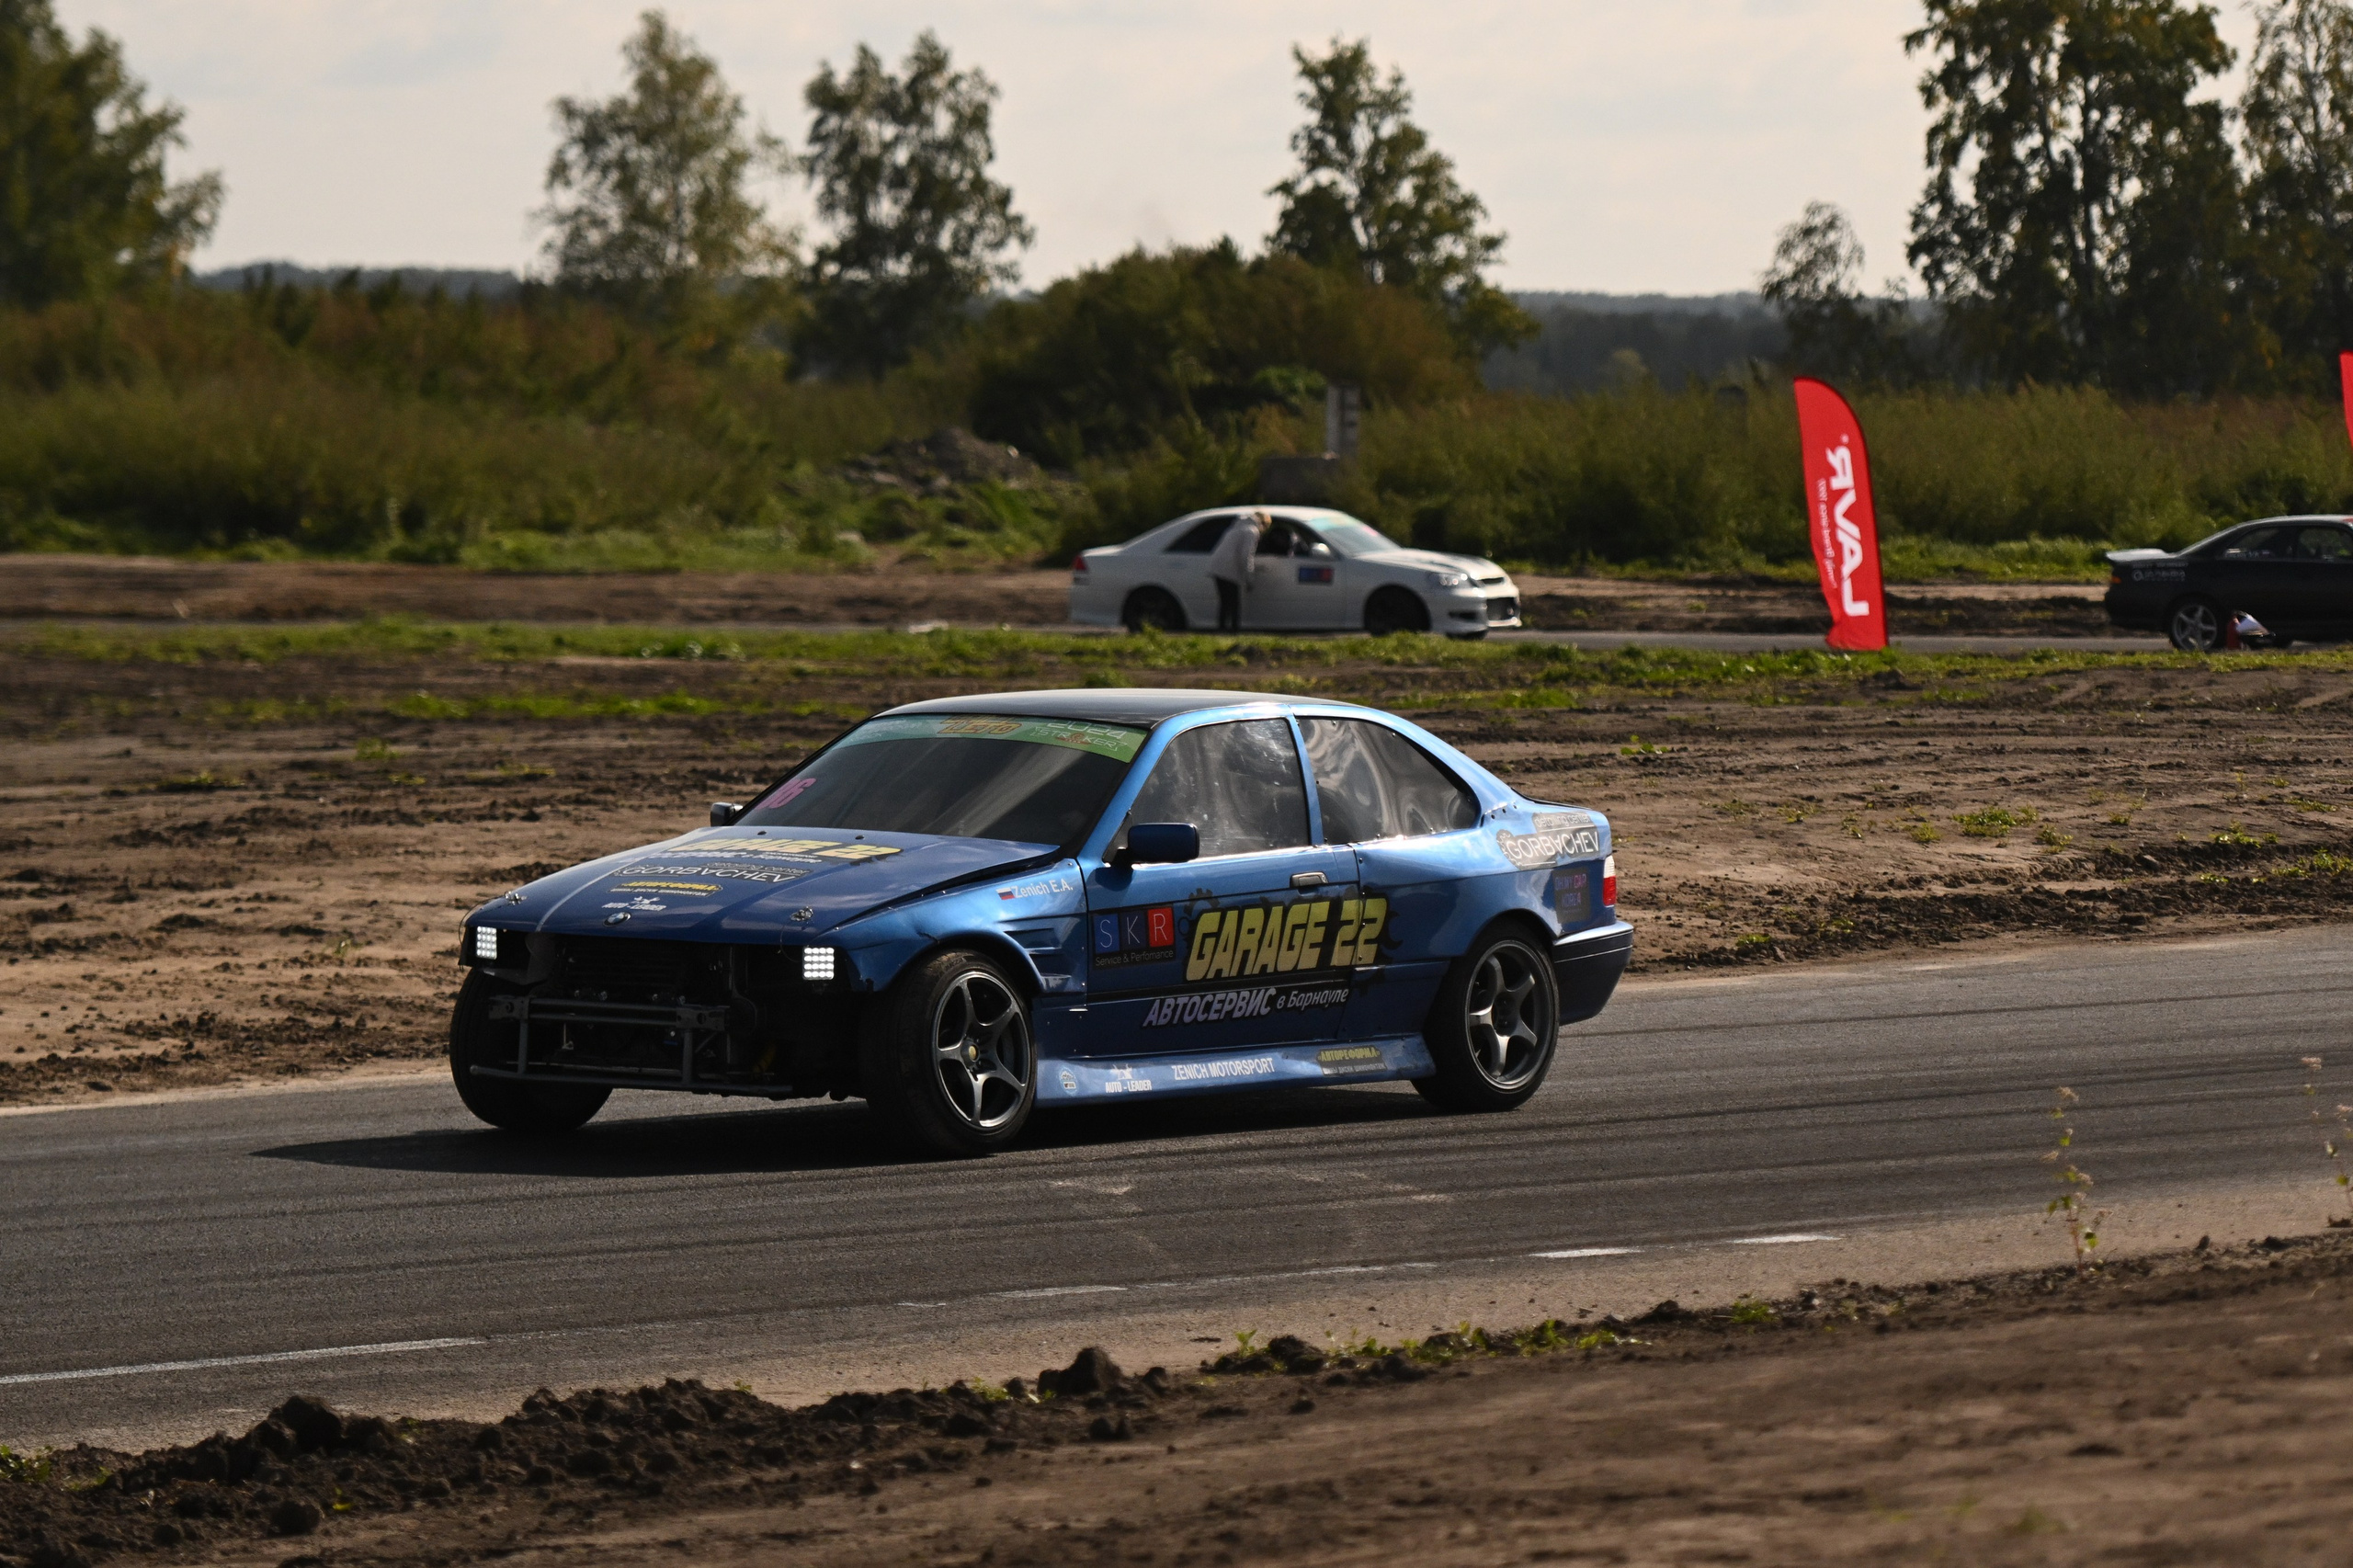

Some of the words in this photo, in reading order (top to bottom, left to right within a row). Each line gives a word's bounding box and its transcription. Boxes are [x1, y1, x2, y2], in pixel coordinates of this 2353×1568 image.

[1012, 881, 1050, 899] Zenich
[1186, 901, 1331, 981] GARAGE
[1331, 897, 1388, 967] 22
[1096, 955, 1121, 966] Service
[1123, 954, 1129, 963] &
[1142, 987, 1277, 1028] АВТОСЕРВИС
[1277, 996, 1285, 1009] в
[1288, 987, 1349, 1011] Барнауле
[1171, 1064, 1209, 1081] ZENICH
[1209, 1058, 1276, 1078] MOTORSPORT
[1105, 1081, 1122, 1094] AUTO
[1127, 1080, 1152, 1093] LEADER
